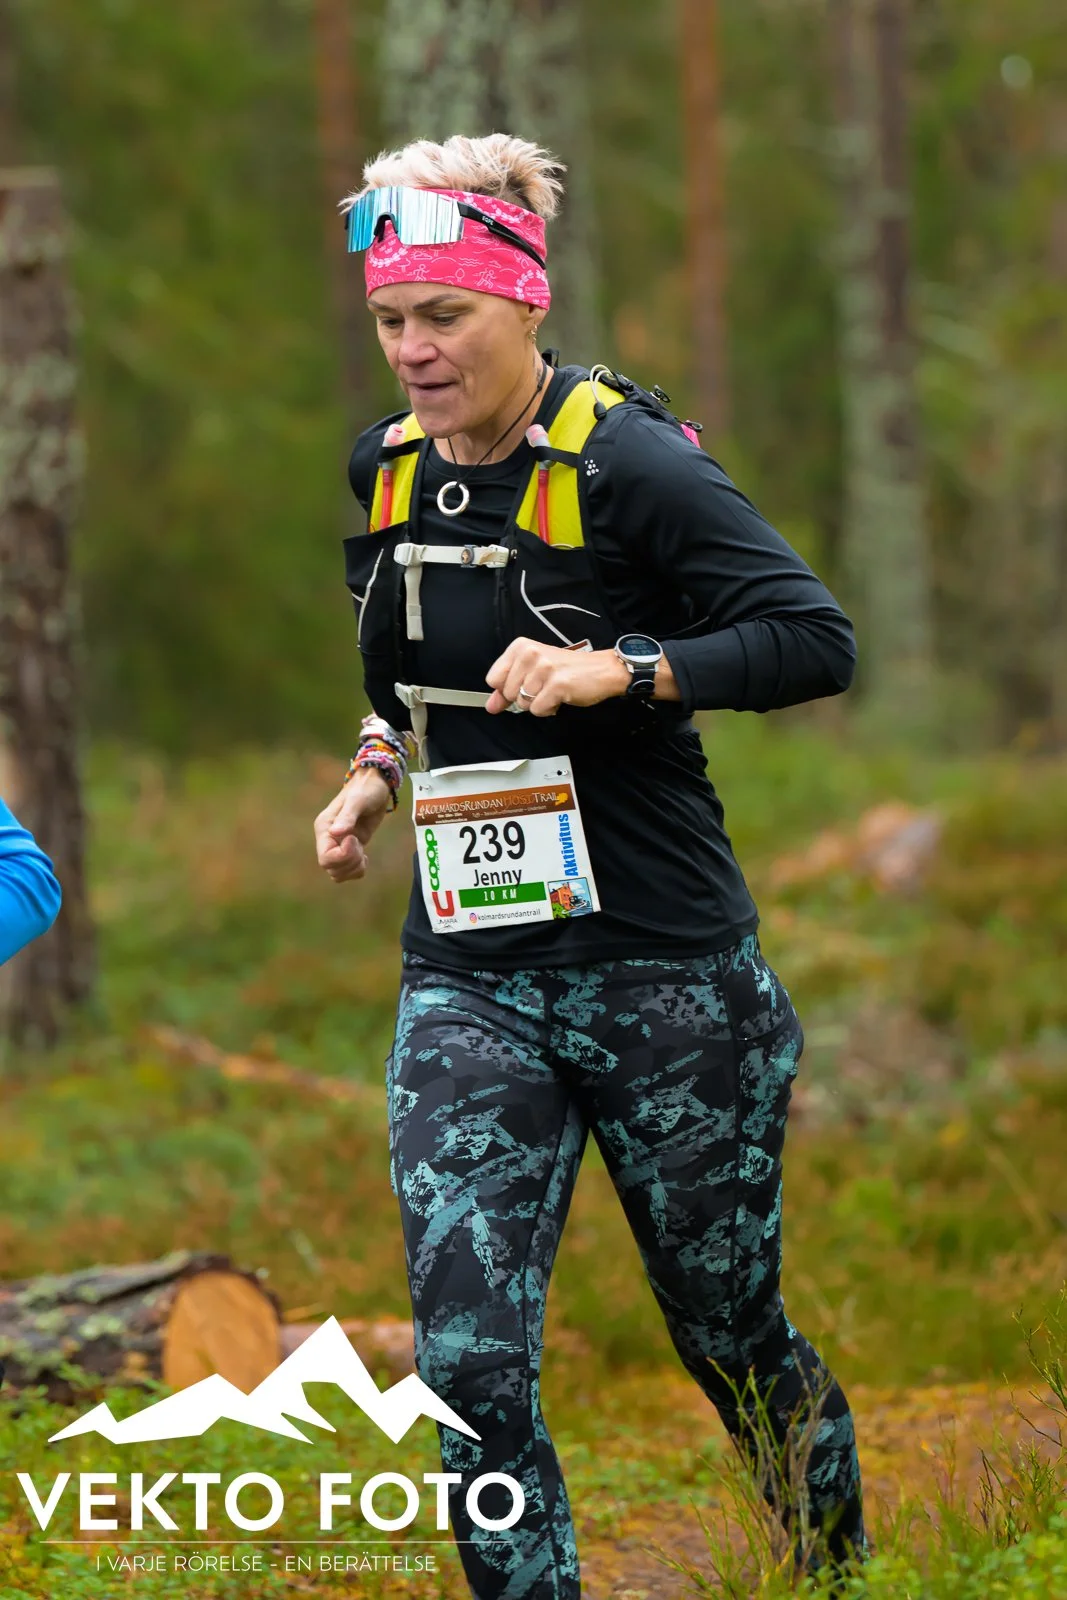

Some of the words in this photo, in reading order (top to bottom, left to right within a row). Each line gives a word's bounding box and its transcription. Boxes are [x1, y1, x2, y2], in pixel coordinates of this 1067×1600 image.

[425, 828, 440, 891] coop
[459, 820, 526, 865] 239
[558, 813, 579, 877] Aktivitus
[473, 869, 522, 888] Jenny
[484, 890, 496, 902] 10
[502, 888, 517, 900] KM
